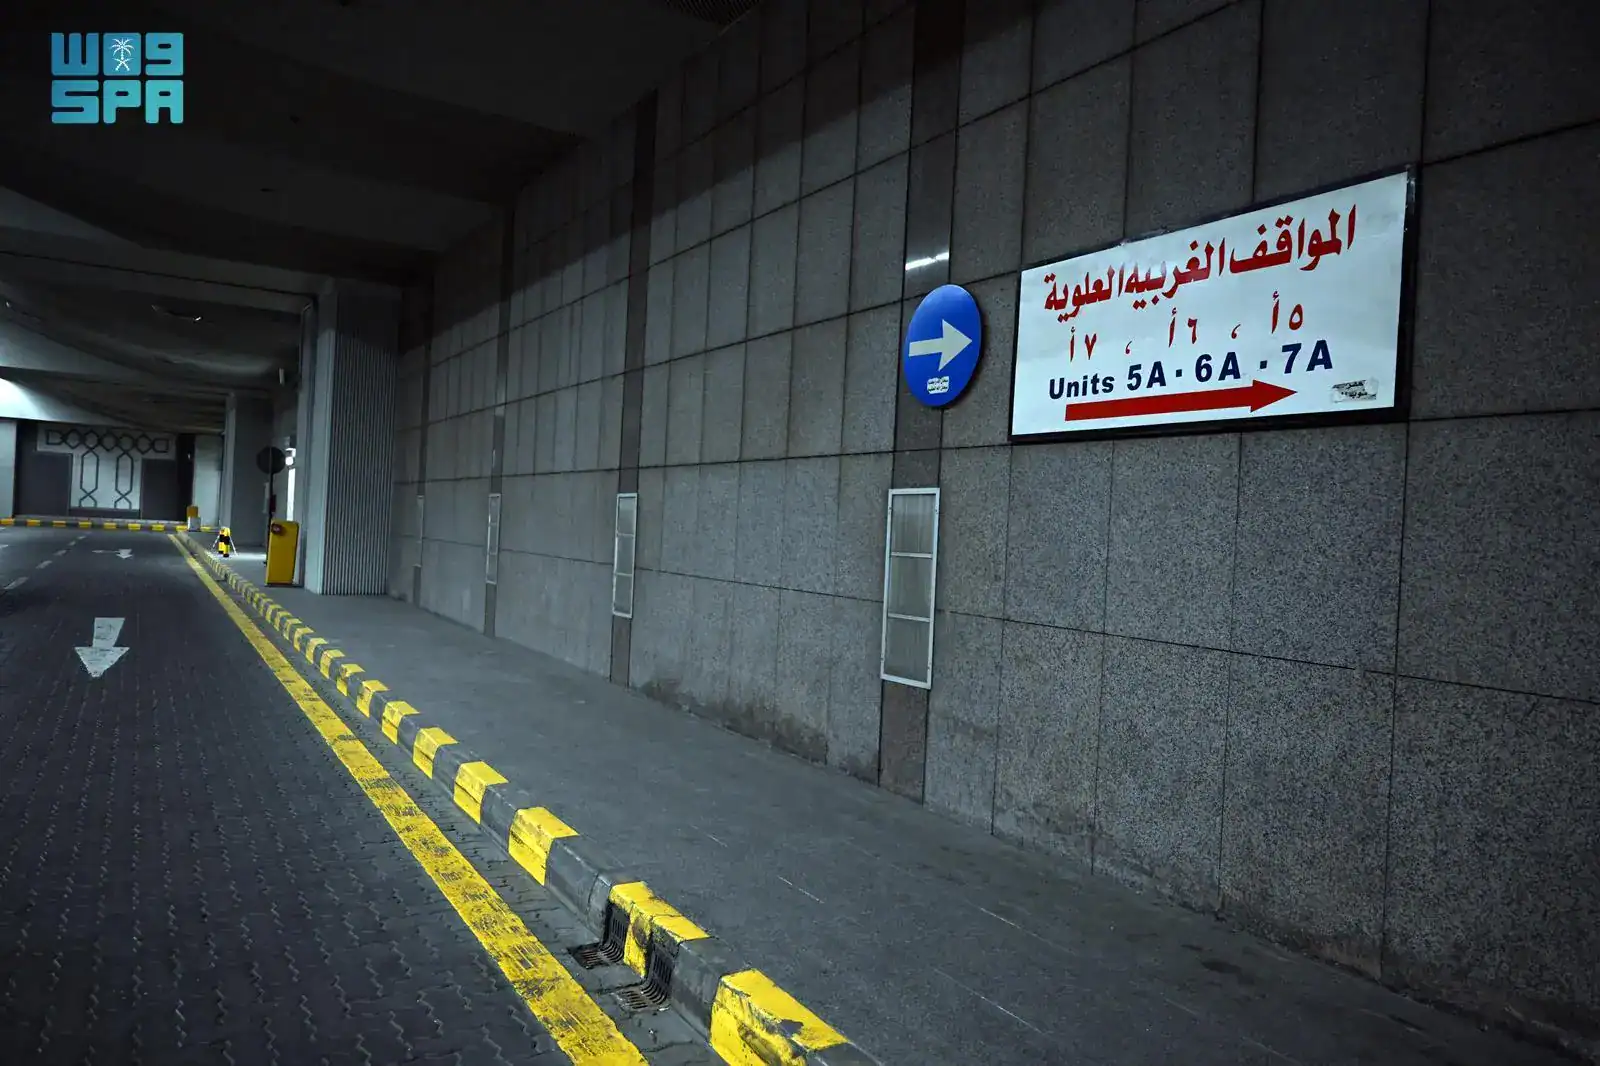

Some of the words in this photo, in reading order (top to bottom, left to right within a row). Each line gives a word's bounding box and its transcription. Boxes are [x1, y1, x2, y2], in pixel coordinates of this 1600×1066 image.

[1229, 204, 1357, 273] المواقف
[1044, 269, 1125, 322] العلوية
[1049, 372, 1115, 399] Units
